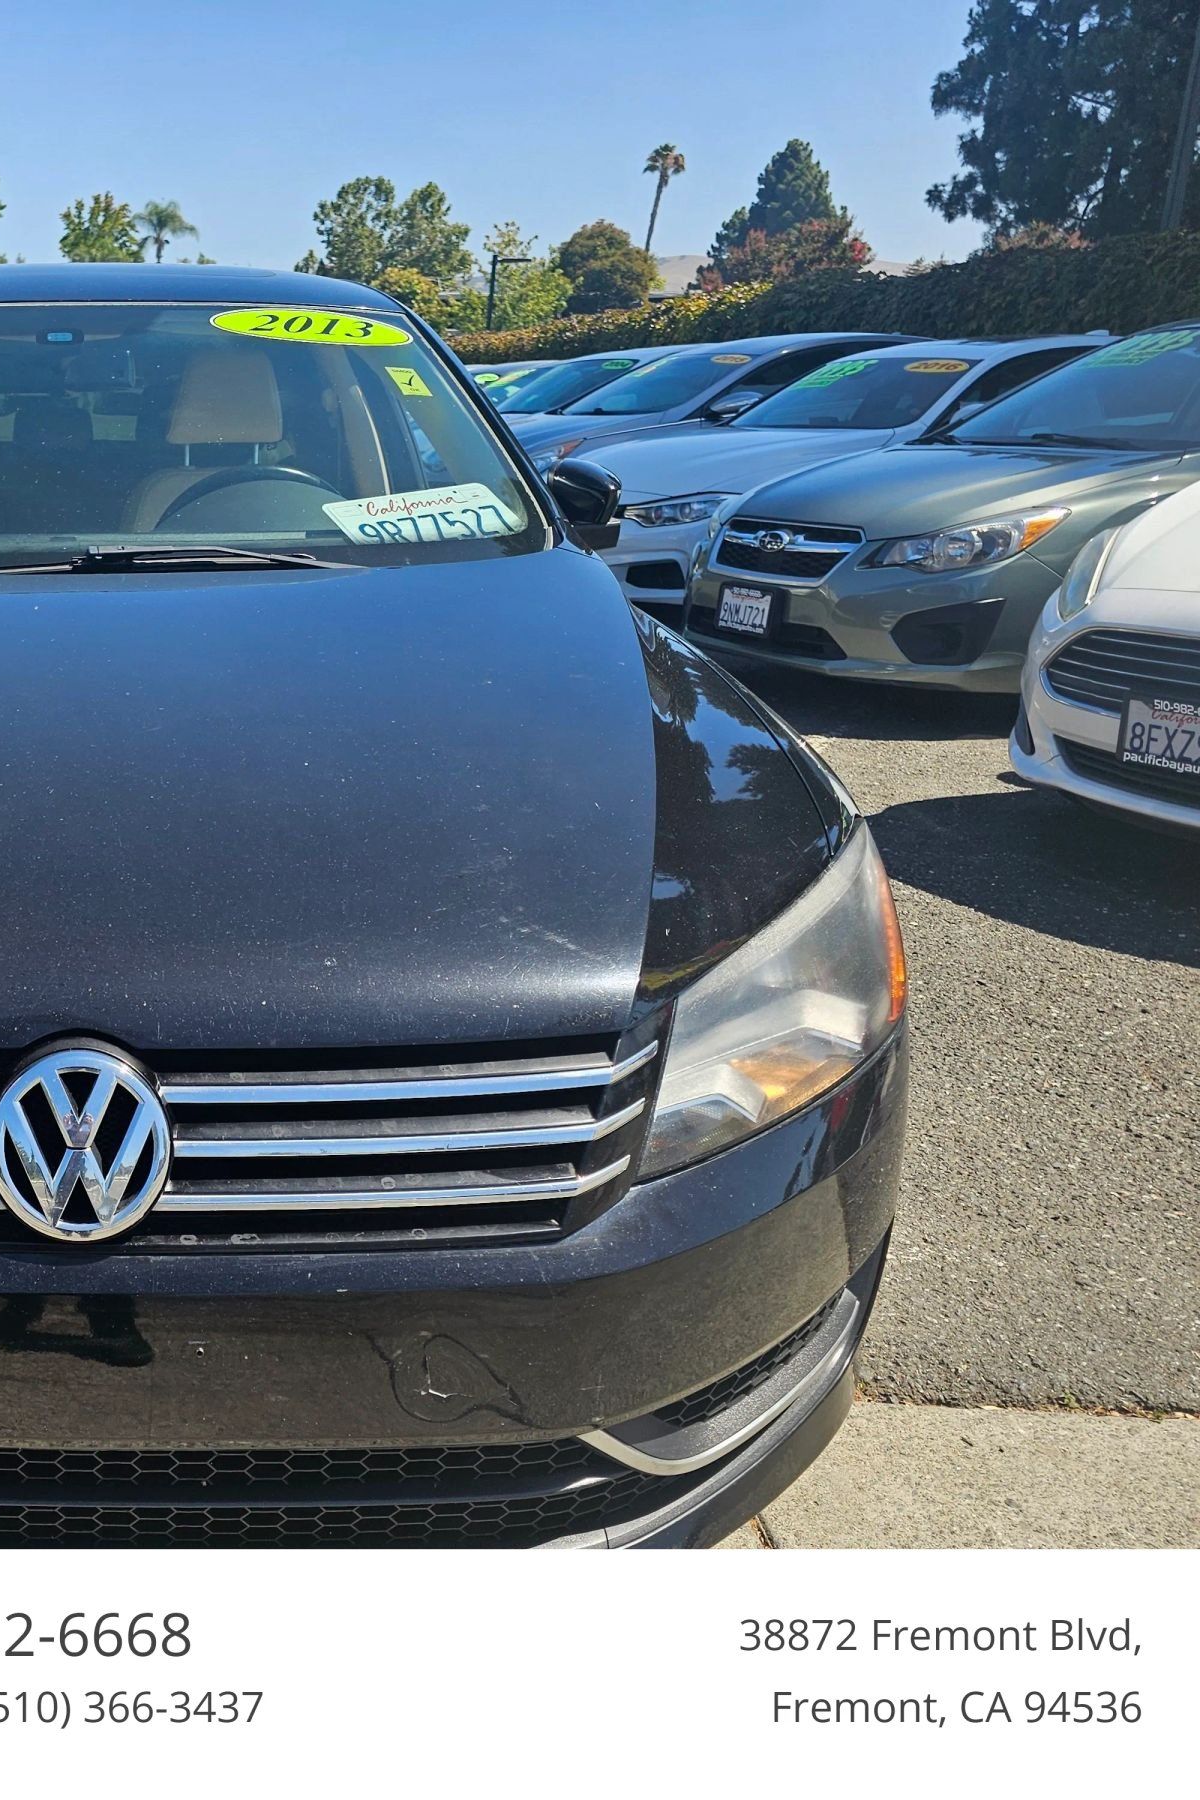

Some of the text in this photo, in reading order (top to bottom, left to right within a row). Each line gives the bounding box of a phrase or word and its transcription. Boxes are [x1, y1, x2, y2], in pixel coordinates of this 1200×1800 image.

[250, 313, 374, 338] 2013
[909, 362, 964, 371] 2016
[366, 493, 468, 516] California
[358, 504, 515, 544] 9R77527
